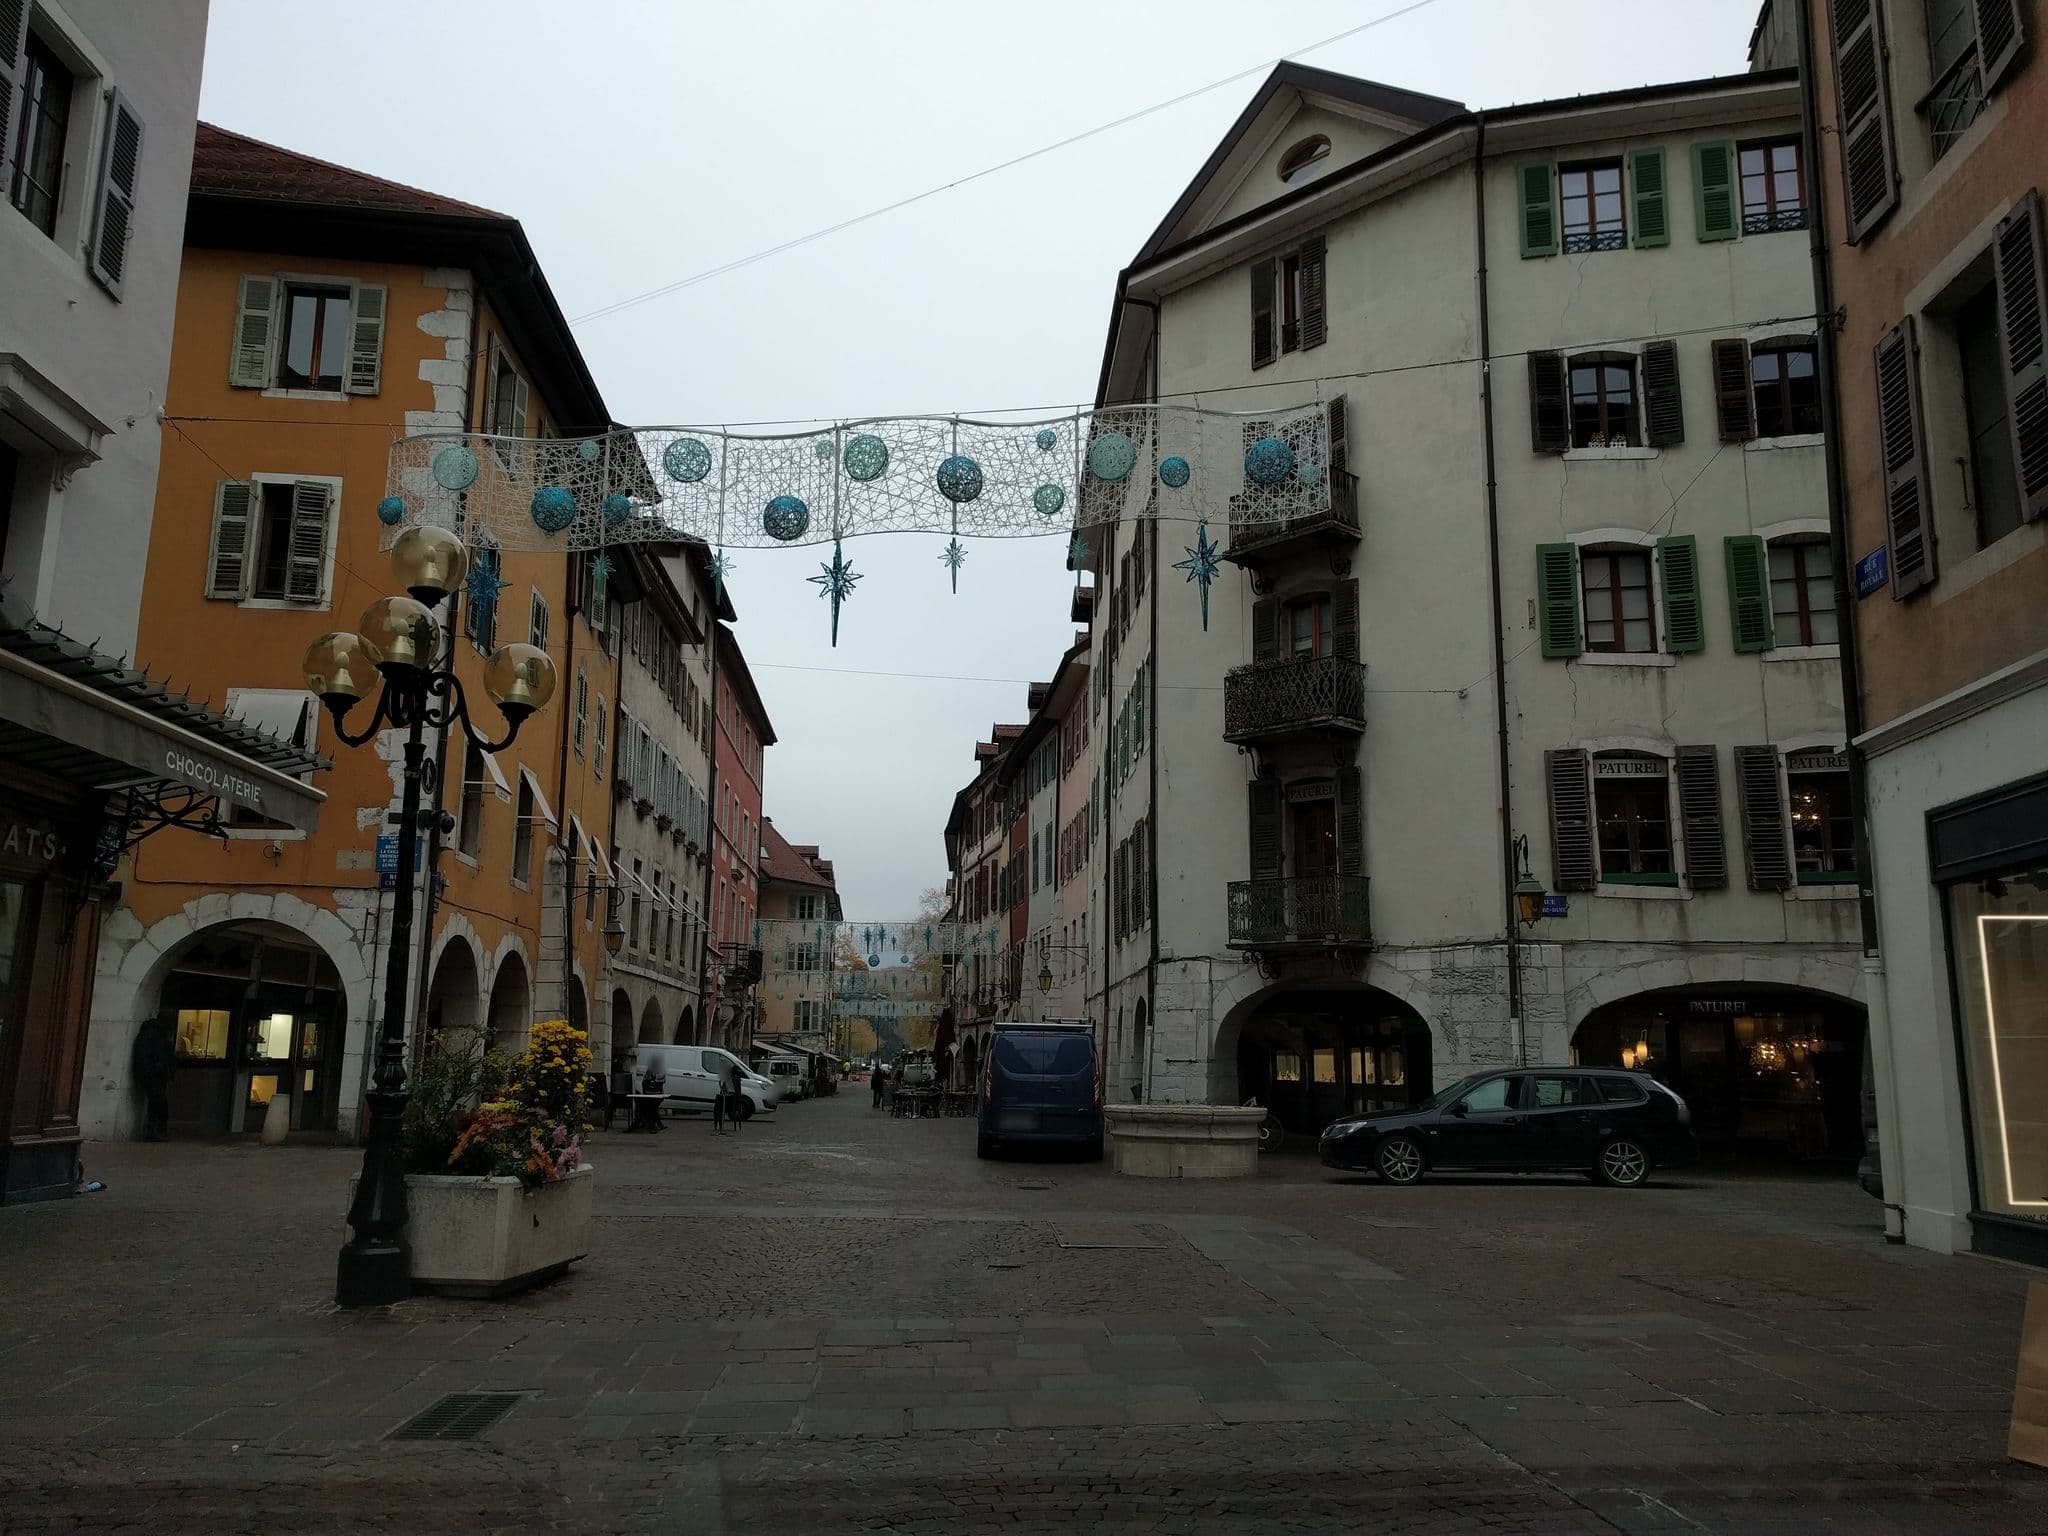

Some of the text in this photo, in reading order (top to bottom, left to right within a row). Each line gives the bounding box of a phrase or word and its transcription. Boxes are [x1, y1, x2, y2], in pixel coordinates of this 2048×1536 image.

[1598, 761, 1662, 775] PATUREL
[1789, 752, 1848, 770] PATURE
[166, 751, 262, 804] CHOCOLATERIE
